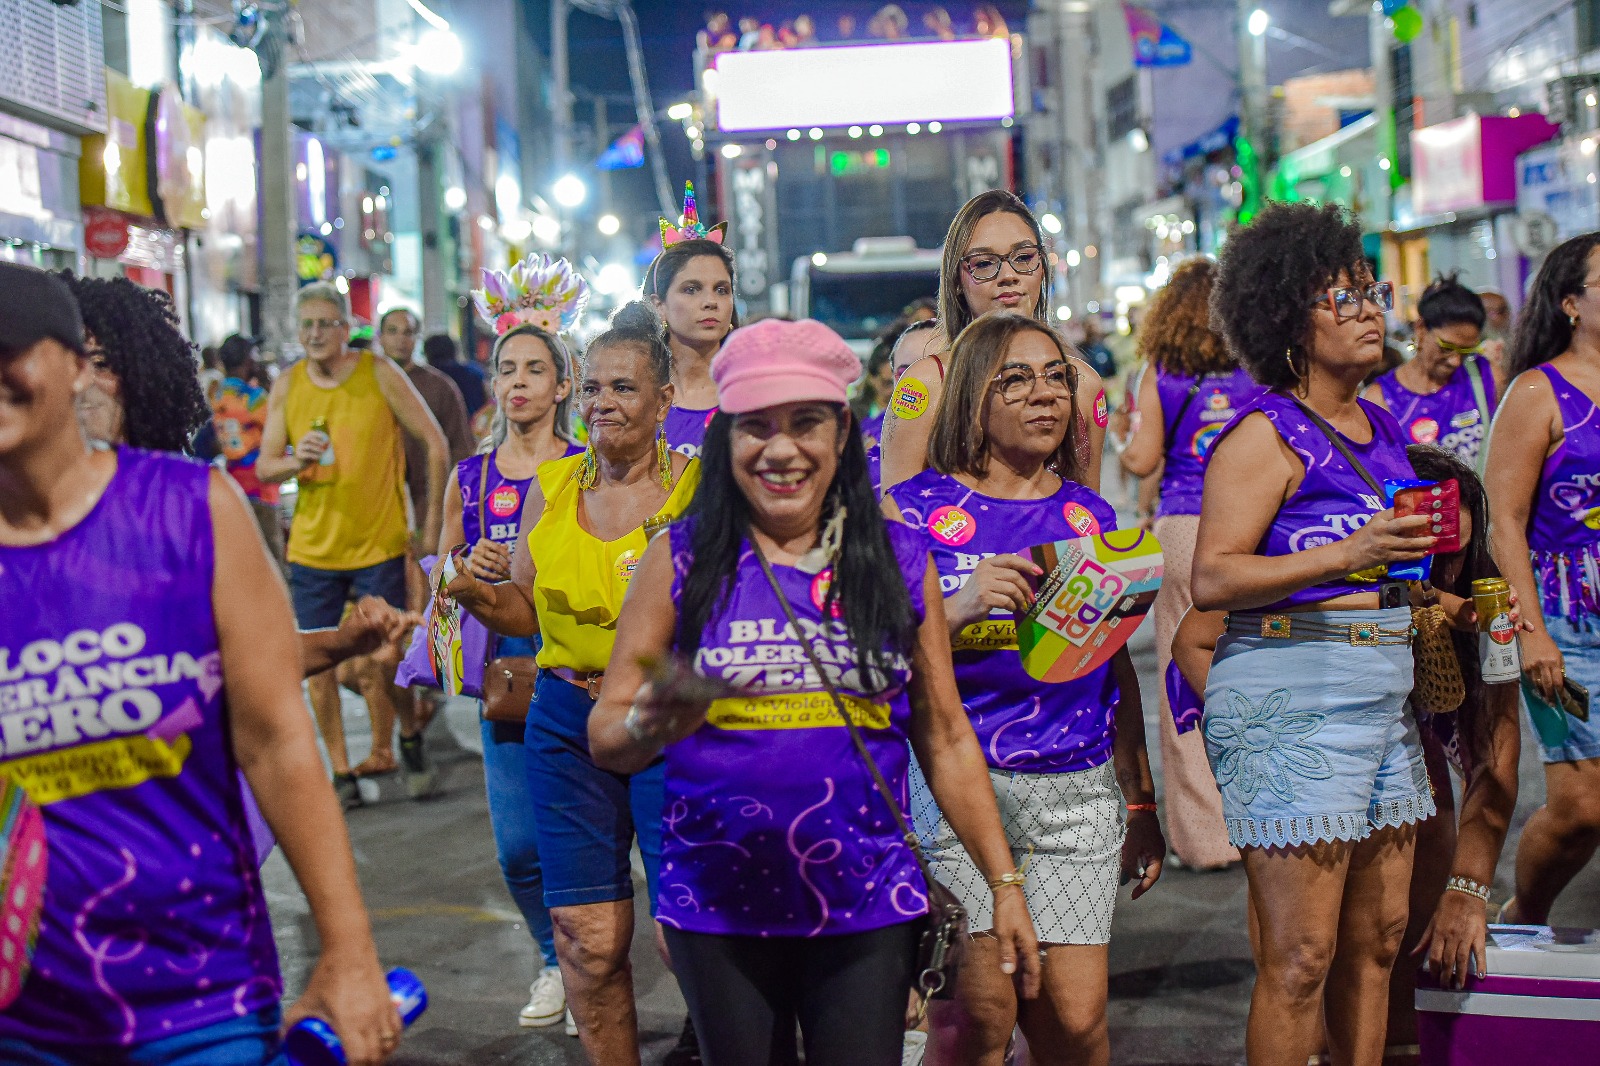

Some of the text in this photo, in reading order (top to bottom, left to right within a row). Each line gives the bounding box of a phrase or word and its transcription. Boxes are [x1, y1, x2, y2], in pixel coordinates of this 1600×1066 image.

[931, 510, 967, 535] NÃO
[1045, 558, 1107, 631] LGBT
[1065, 574, 1123, 639] CPDD
[722, 662, 889, 693] ZERO
[0, 688, 164, 757] ERO
[798, 712, 811, 723] a
